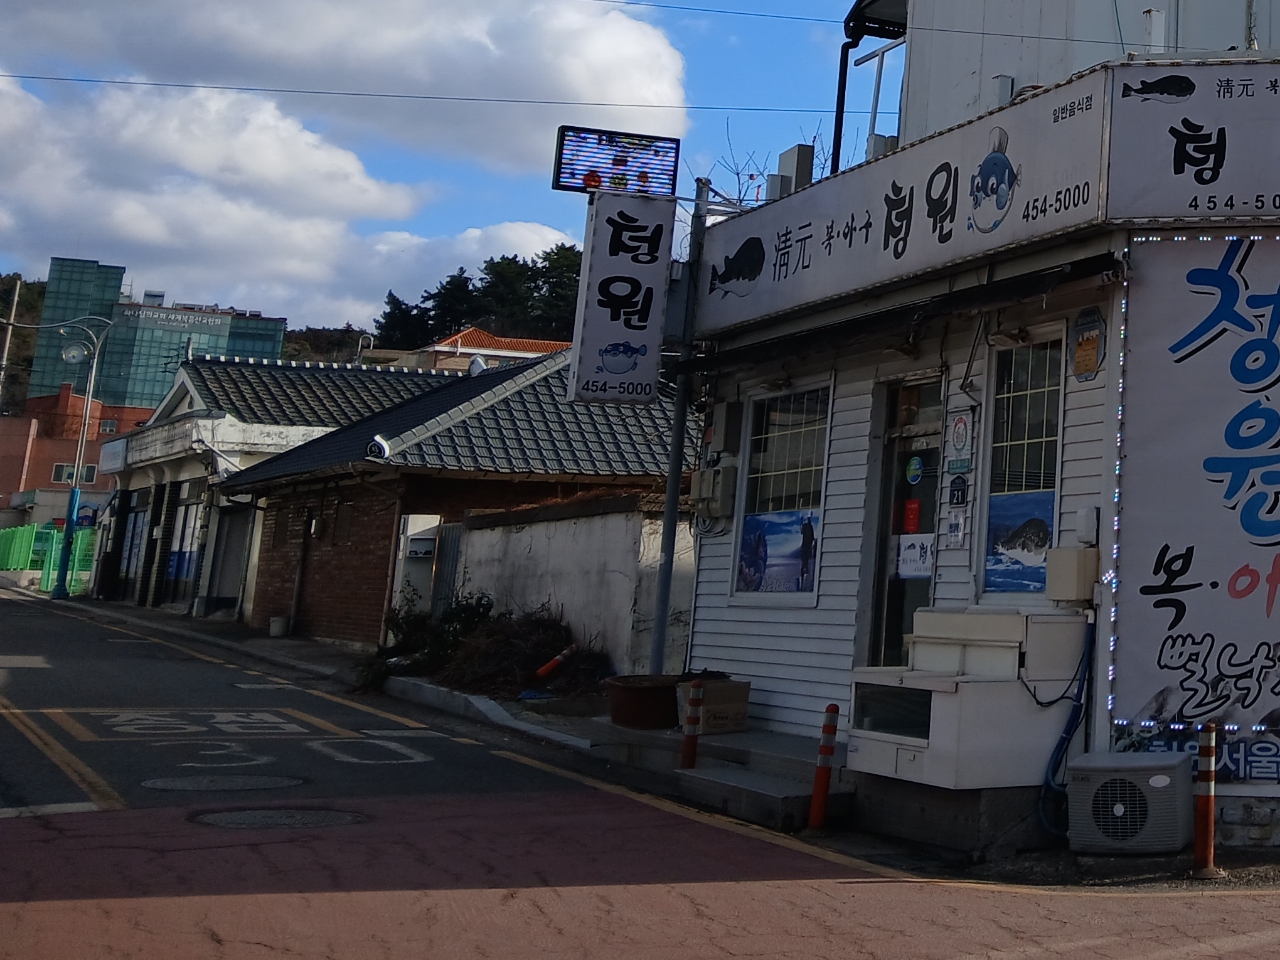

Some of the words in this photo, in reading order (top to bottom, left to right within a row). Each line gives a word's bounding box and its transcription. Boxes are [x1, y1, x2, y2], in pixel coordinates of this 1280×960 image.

[1052, 93, 1093, 124] 일반음식점
[1022, 181, 1090, 223] 454-5000
[582, 380, 652, 396] 454-5000
[953, 490, 962, 503] 21
[90, 712, 310, 733] 종점
[151, 739, 435, 767] 30
